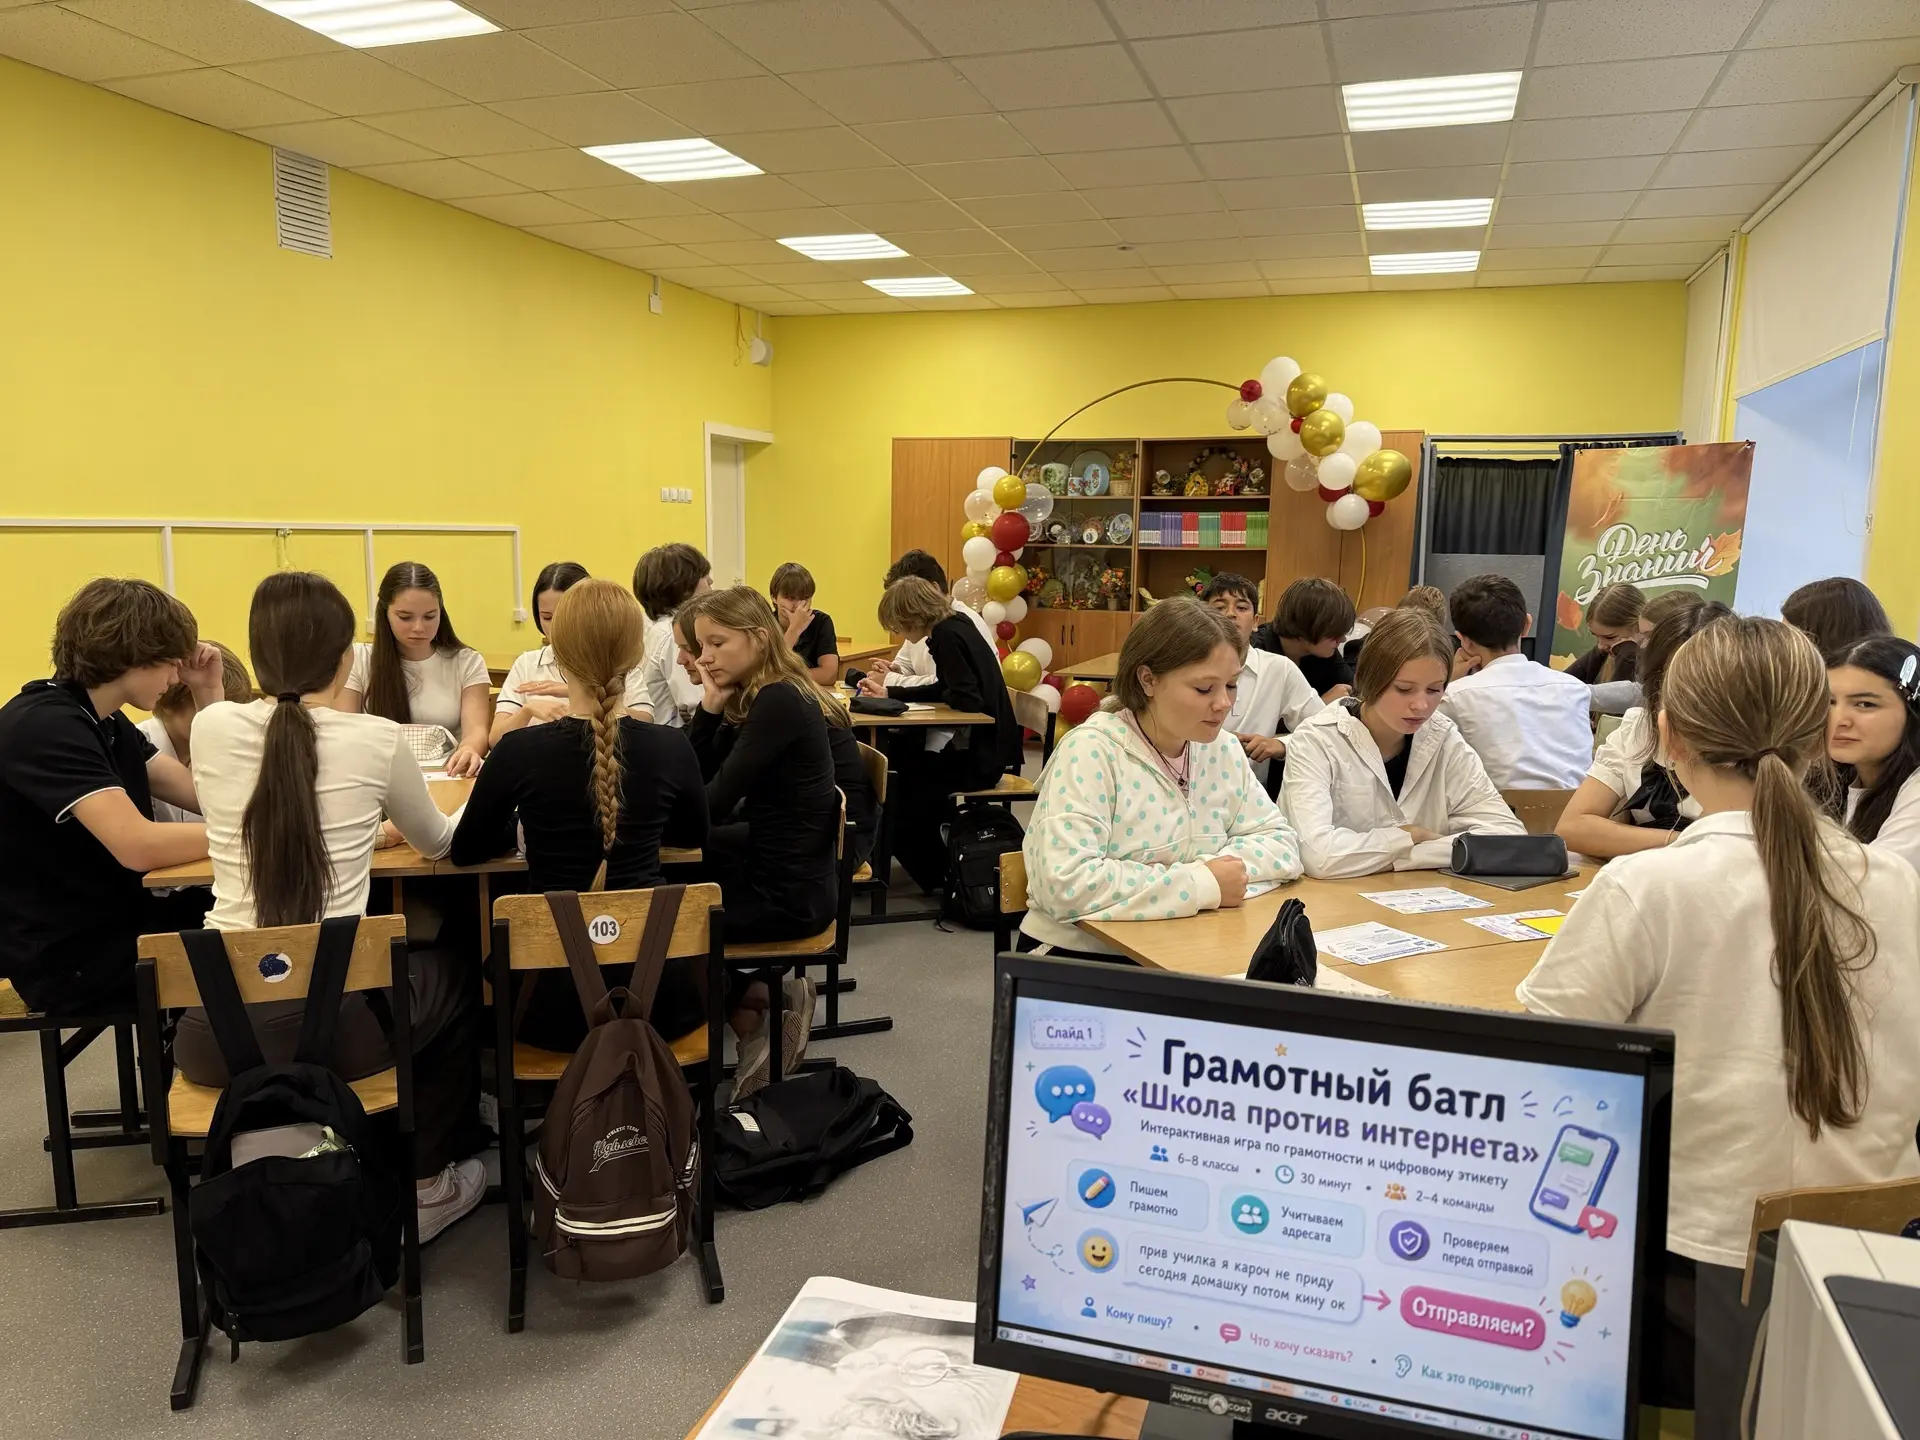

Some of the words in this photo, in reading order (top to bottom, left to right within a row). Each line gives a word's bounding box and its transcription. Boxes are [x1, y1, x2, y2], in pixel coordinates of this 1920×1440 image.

[1597, 523, 1687, 562] День
[1574, 536, 1723, 605] Знаний
[592, 921, 617, 937] 103
[1046, 1026, 1084, 1040] Слайд
[1087, 1028, 1092, 1039] 1
[1163, 1038, 1391, 1107] Грамотный
[1408, 1073, 1506, 1122] батл
[1123, 1081, 1236, 1121] «Школа
[1247, 1104, 1349, 1138] против
[1361, 1121, 1539, 1164] интернета»
[1140, 1119, 1230, 1145] Интерактивная
[1234, 1137, 1261, 1153] игра
[1265, 1142, 1280, 1152] по
[1284, 1145, 1363, 1166] грамотности
[1368, 1157, 1375, 1167] и
[1380, 1158, 1453, 1180] цифровому
[1458, 1171, 1508, 1189] этикету
[1203, 1158, 1239, 1173] классы
[1130, 1181, 1168, 1198] Пишем
[1301, 1172, 1315, 1184] 30
[1319, 1178, 1352, 1191] минут
[1129, 1201, 1178, 1217] грамотно
[1443, 1195, 1495, 1213] команды
[1281, 1206, 1343, 1227] Учитываем
[1282, 1225, 1331, 1243] адресата
[1443, 1232, 1509, 1254] Проверяем
[1140, 1244, 1168, 1260] прив
[1173, 1251, 1216, 1267] училка
[1222, 1259, 1229, 1269] я
[1235, 1262, 1270, 1279] кароч
[1276, 1269, 1290, 1280] не
[1296, 1272, 1334, 1292] приду
[1442, 1252, 1474, 1269] перед
[1478, 1257, 1533, 1276] отправкой
[1138, 1264, 1187, 1283] сегодня
[1191, 1274, 1248, 1296] домашку
[1253, 1285, 1289, 1301] потом
[1295, 1292, 1325, 1309] кину
[1331, 1300, 1346, 1311] ок
[1106, 1305, 1135, 1324] Кому
[1137, 1311, 1173, 1330] пишу?
[1412, 1296, 1535, 1338] Отправляем?
[1250, 1332, 1270, 1347] Что
[1274, 1338, 1300, 1356] хочу
[1303, 1343, 1353, 1362] сказать?
[1421, 1364, 1445, 1381] Как
[1447, 1368, 1465, 1384] это
[1469, 1374, 1534, 1397] прозвучит?
[1265, 1407, 1308, 1426] acer
